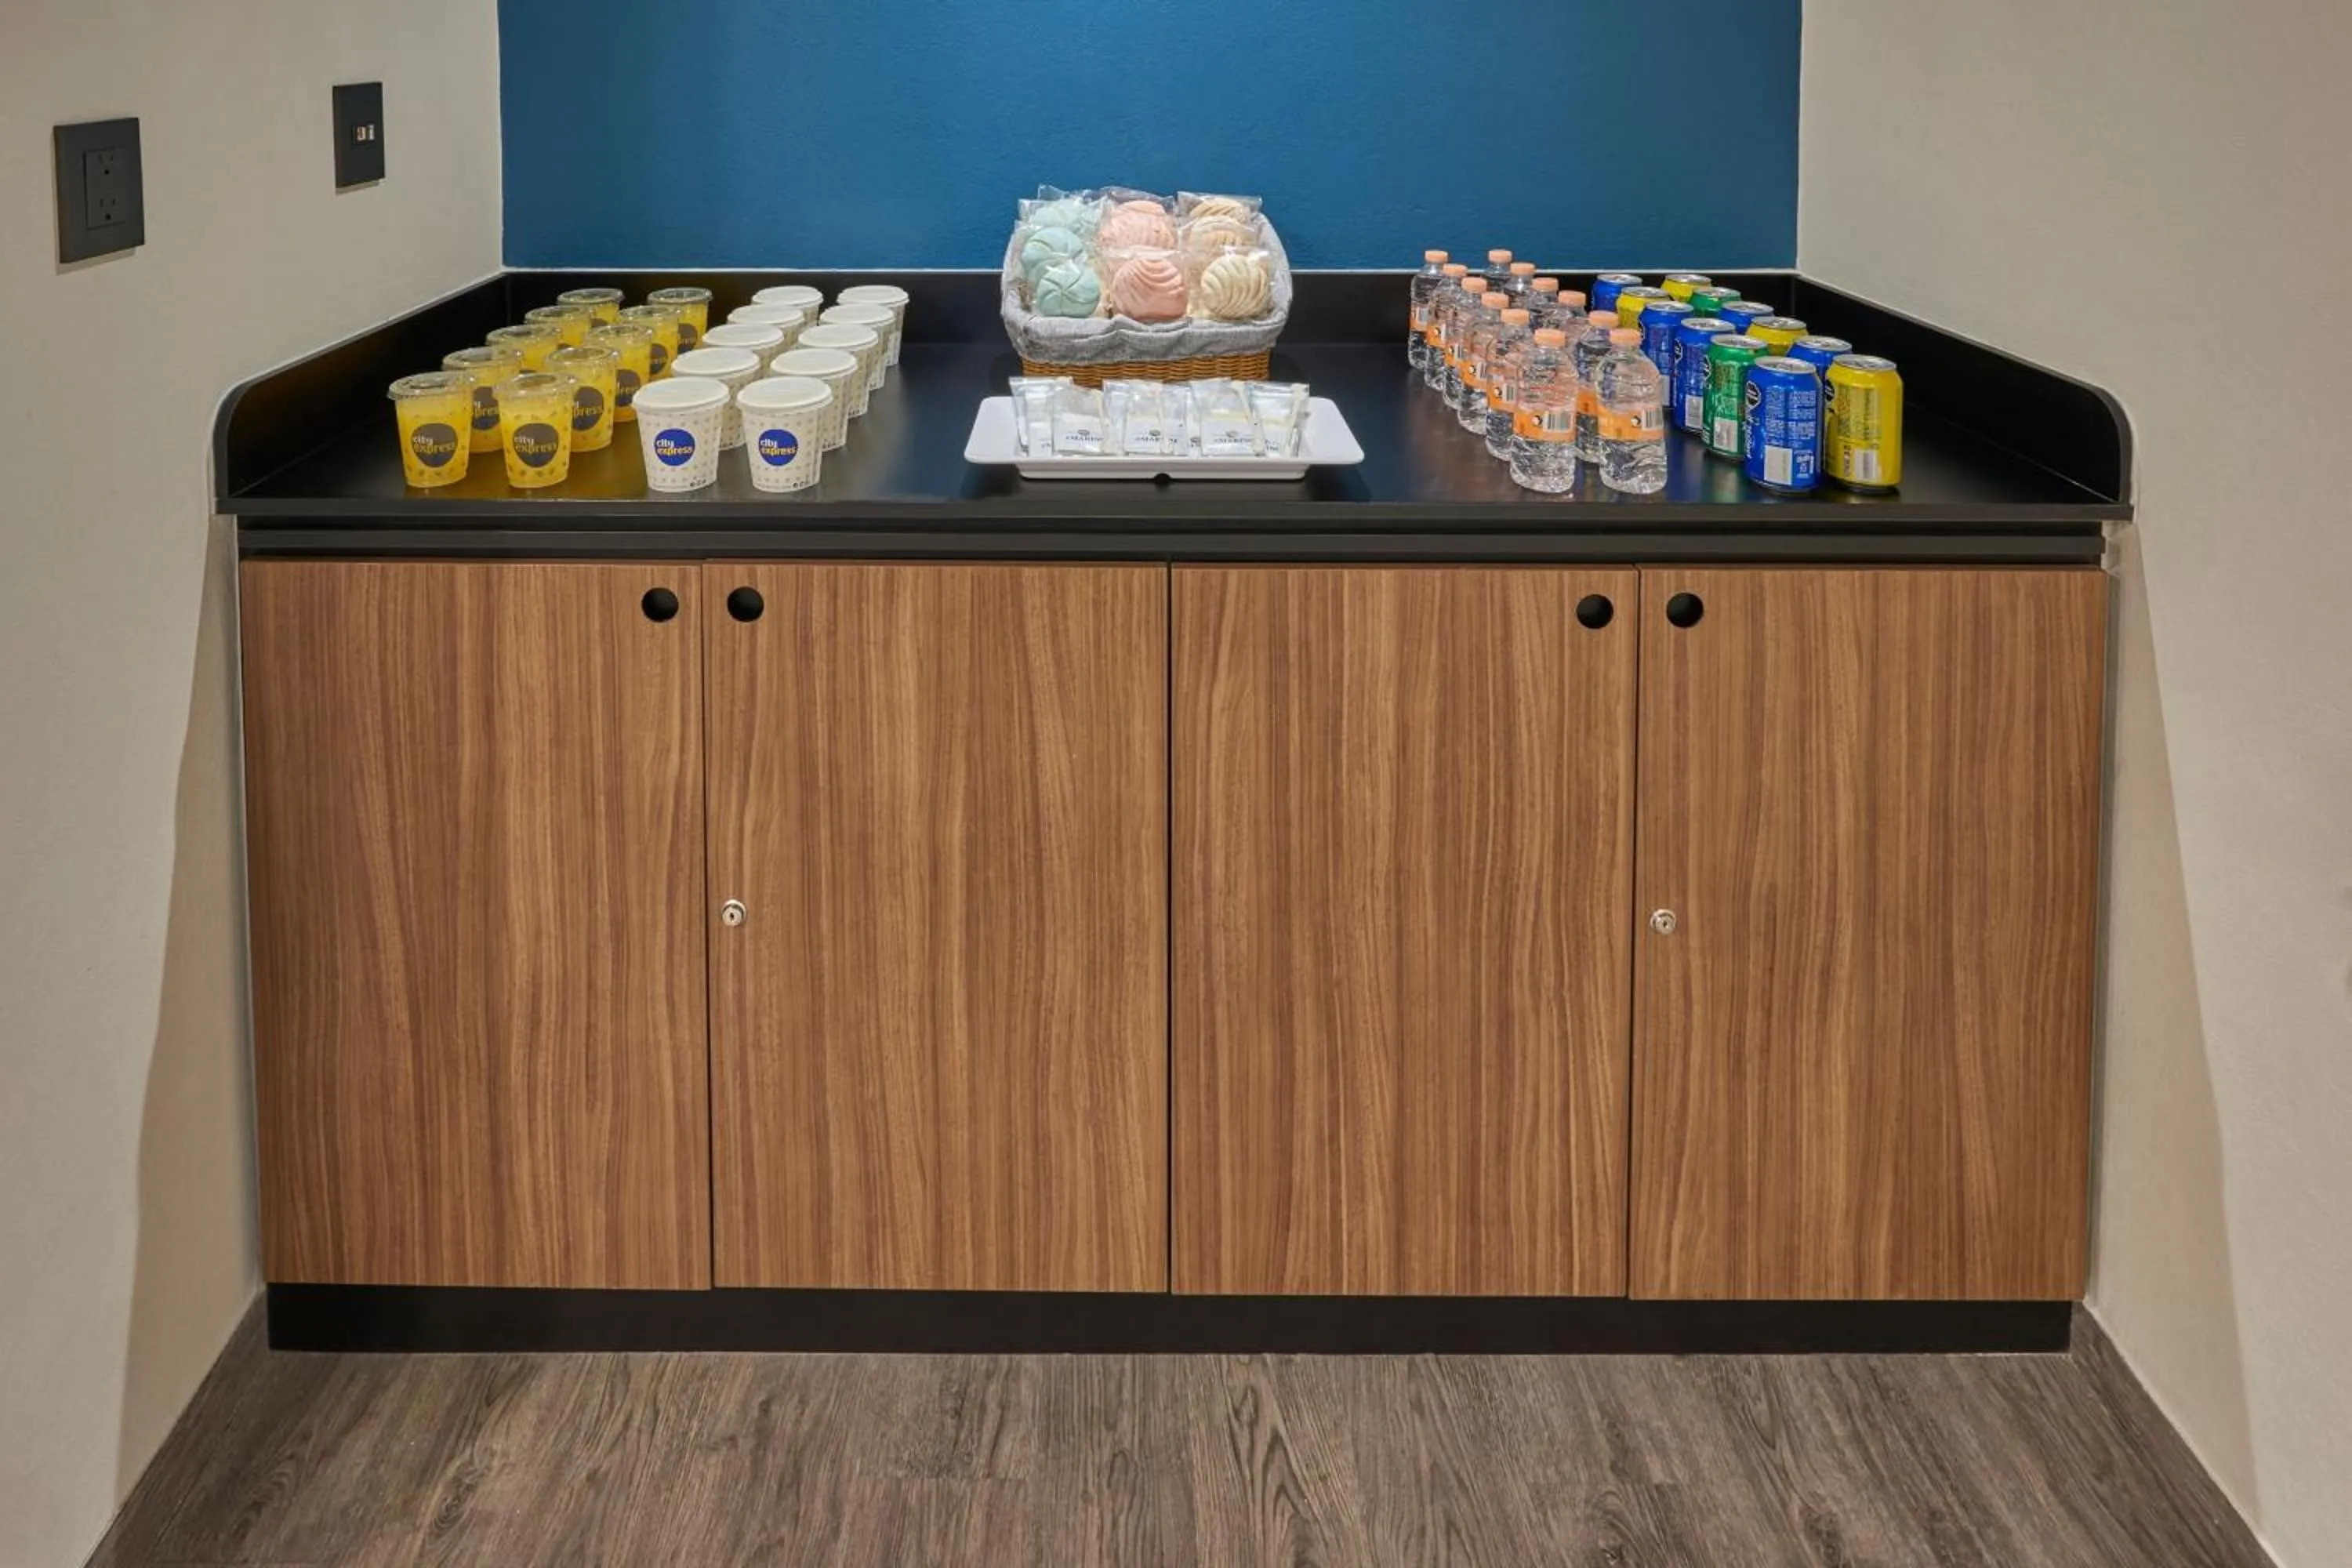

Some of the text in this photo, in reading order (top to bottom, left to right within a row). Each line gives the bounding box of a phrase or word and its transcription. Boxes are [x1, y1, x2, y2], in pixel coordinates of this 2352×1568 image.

[413, 434, 434, 446] city
[514, 435, 534, 446] city
[656, 438, 674, 448] city
[760, 438, 777, 448] city
[414, 442, 455, 454] express
[657, 447, 691, 457] express
[761, 447, 796, 456] express
